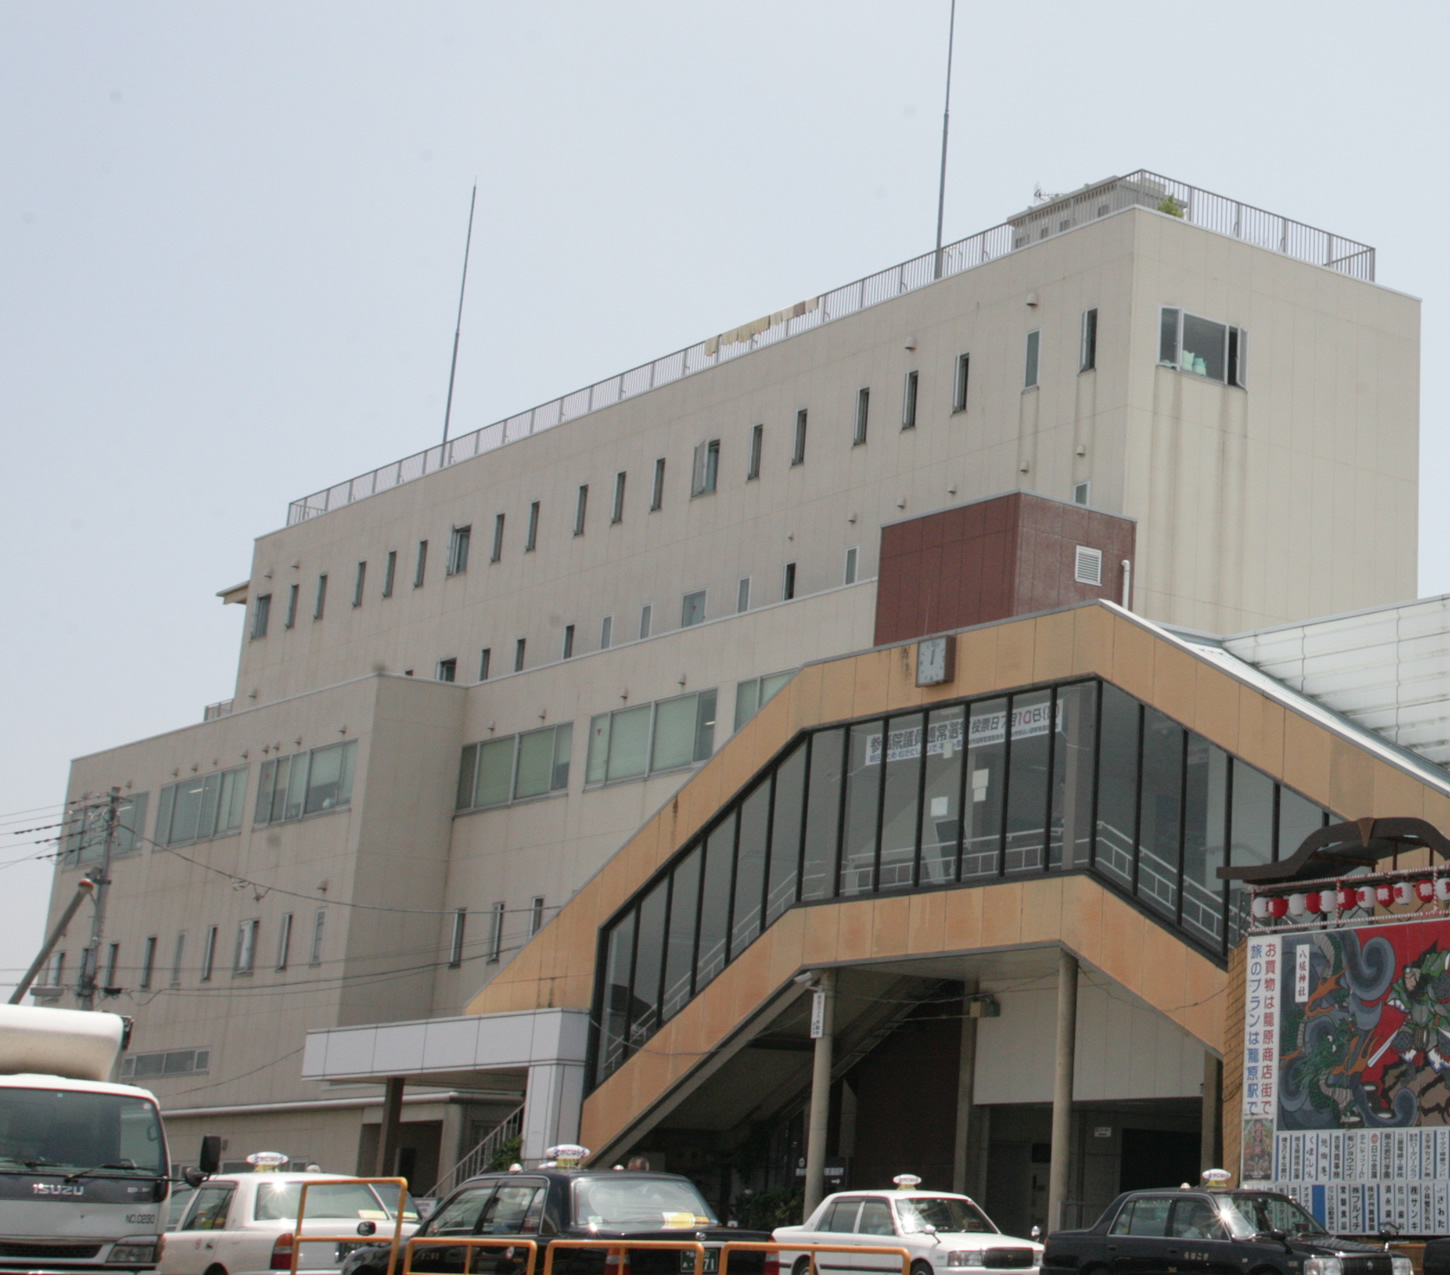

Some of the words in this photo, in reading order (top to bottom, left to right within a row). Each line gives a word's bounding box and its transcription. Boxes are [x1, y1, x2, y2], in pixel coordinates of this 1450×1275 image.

[870, 720, 970, 754] 参院議員通常選挙
[1419, 882, 1433, 896] 祭
[1298, 949, 1307, 997] 八坂神社
[1247, 944, 1263, 1115] 旅のプランは籠原駅で
[1260, 943, 1277, 1115] お買物は籠原商店街で
[32, 1183, 85, 1196] ISUZU
[1384, 1185, 1392, 1219] 須永歯
